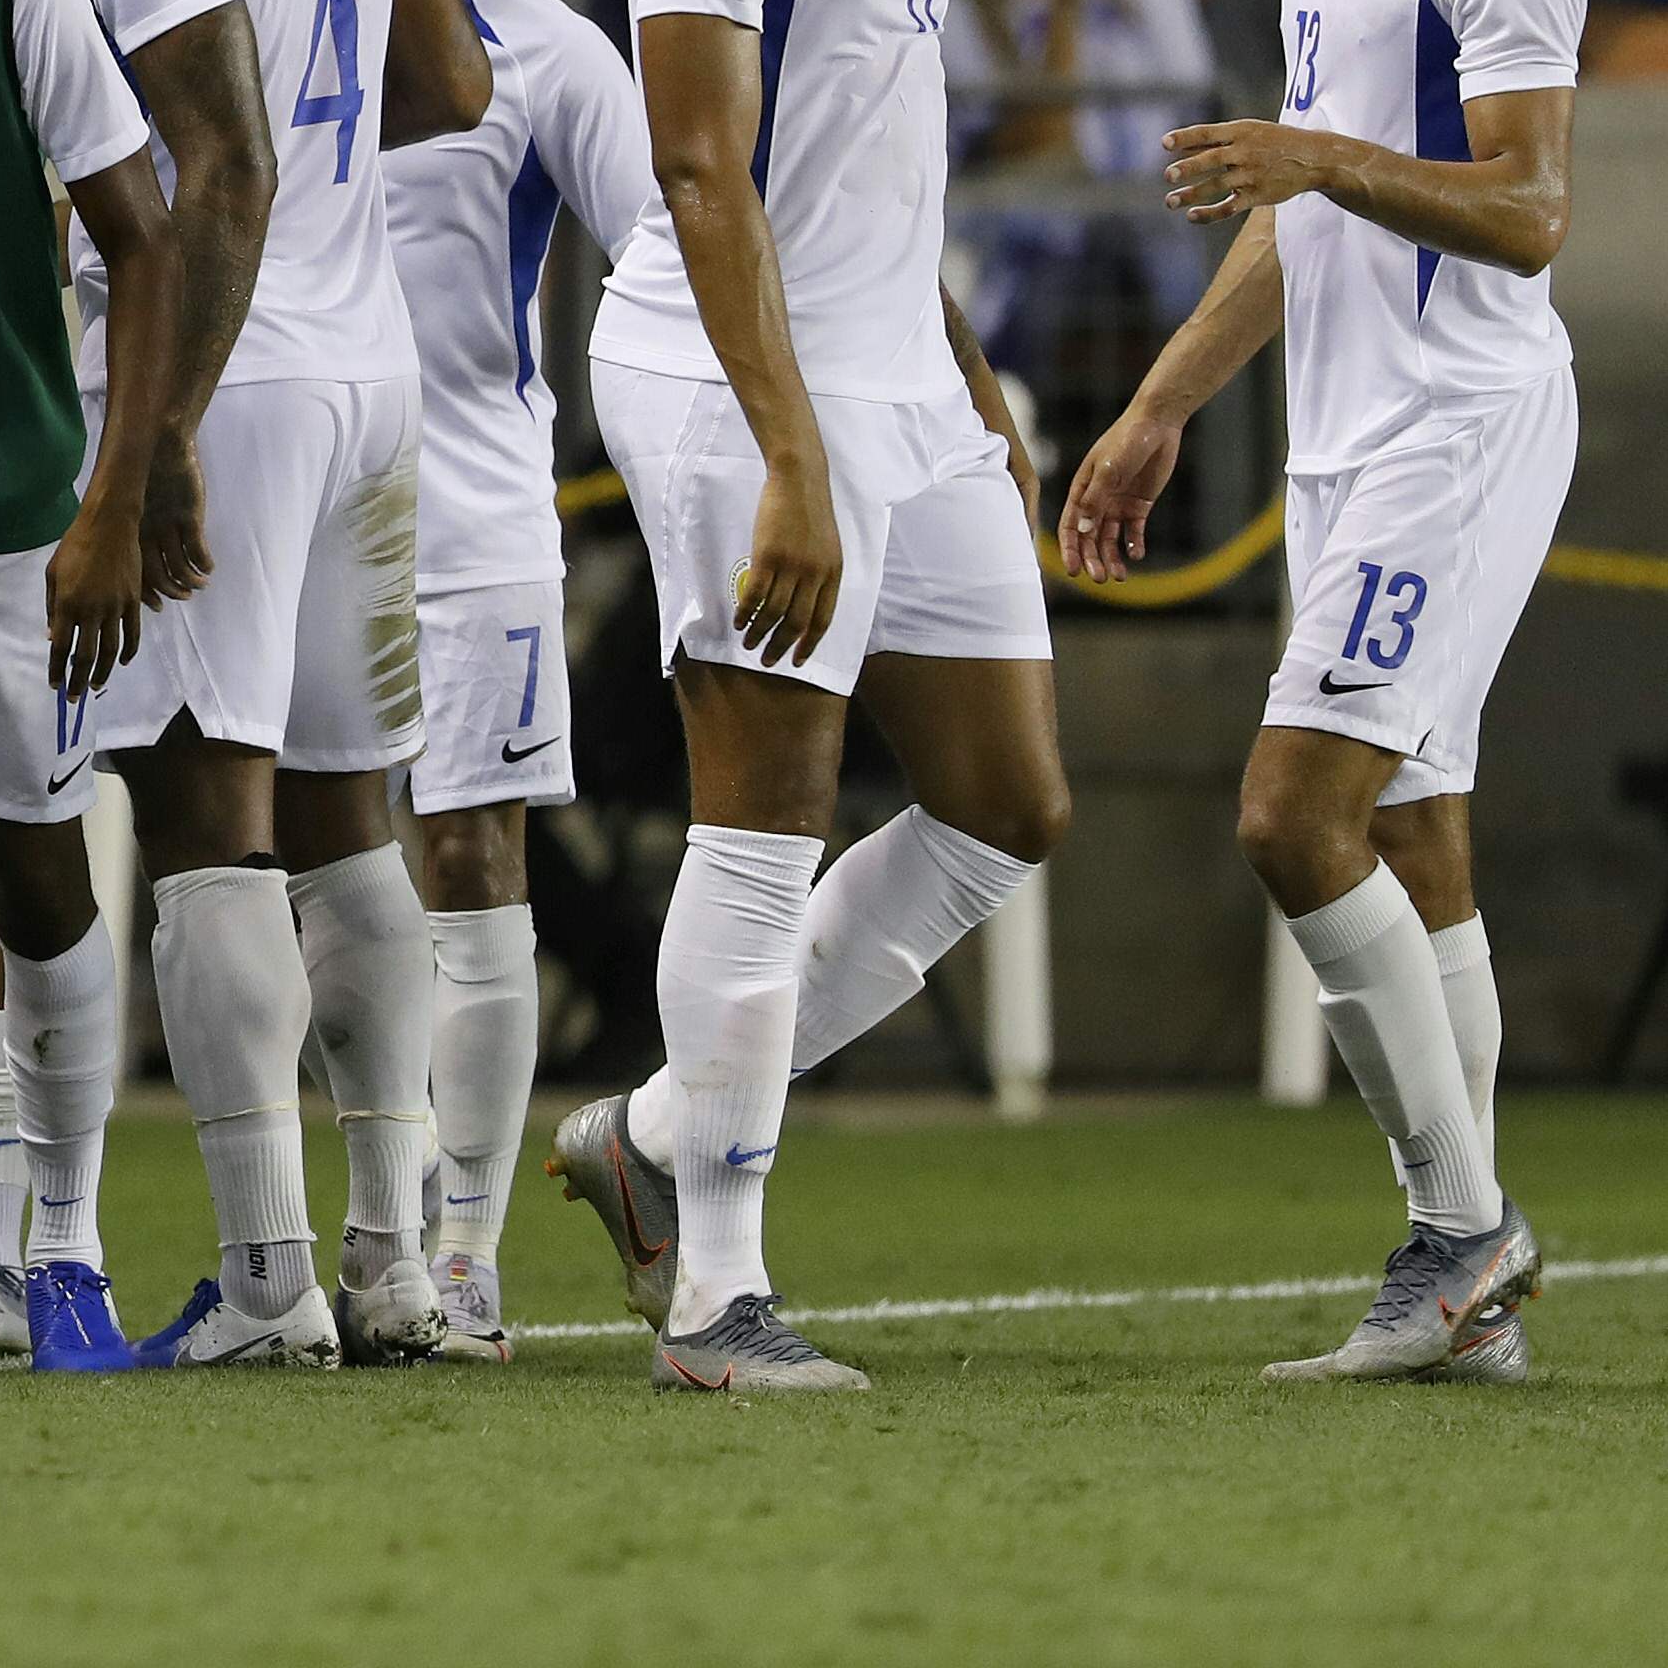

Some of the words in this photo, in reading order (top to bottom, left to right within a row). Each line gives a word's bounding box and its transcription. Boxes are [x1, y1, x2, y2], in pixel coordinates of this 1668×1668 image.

[1284, 10, 1321, 112] 13
[1342, 561, 1427, 670] 13
[505, 625, 541, 729] 7
